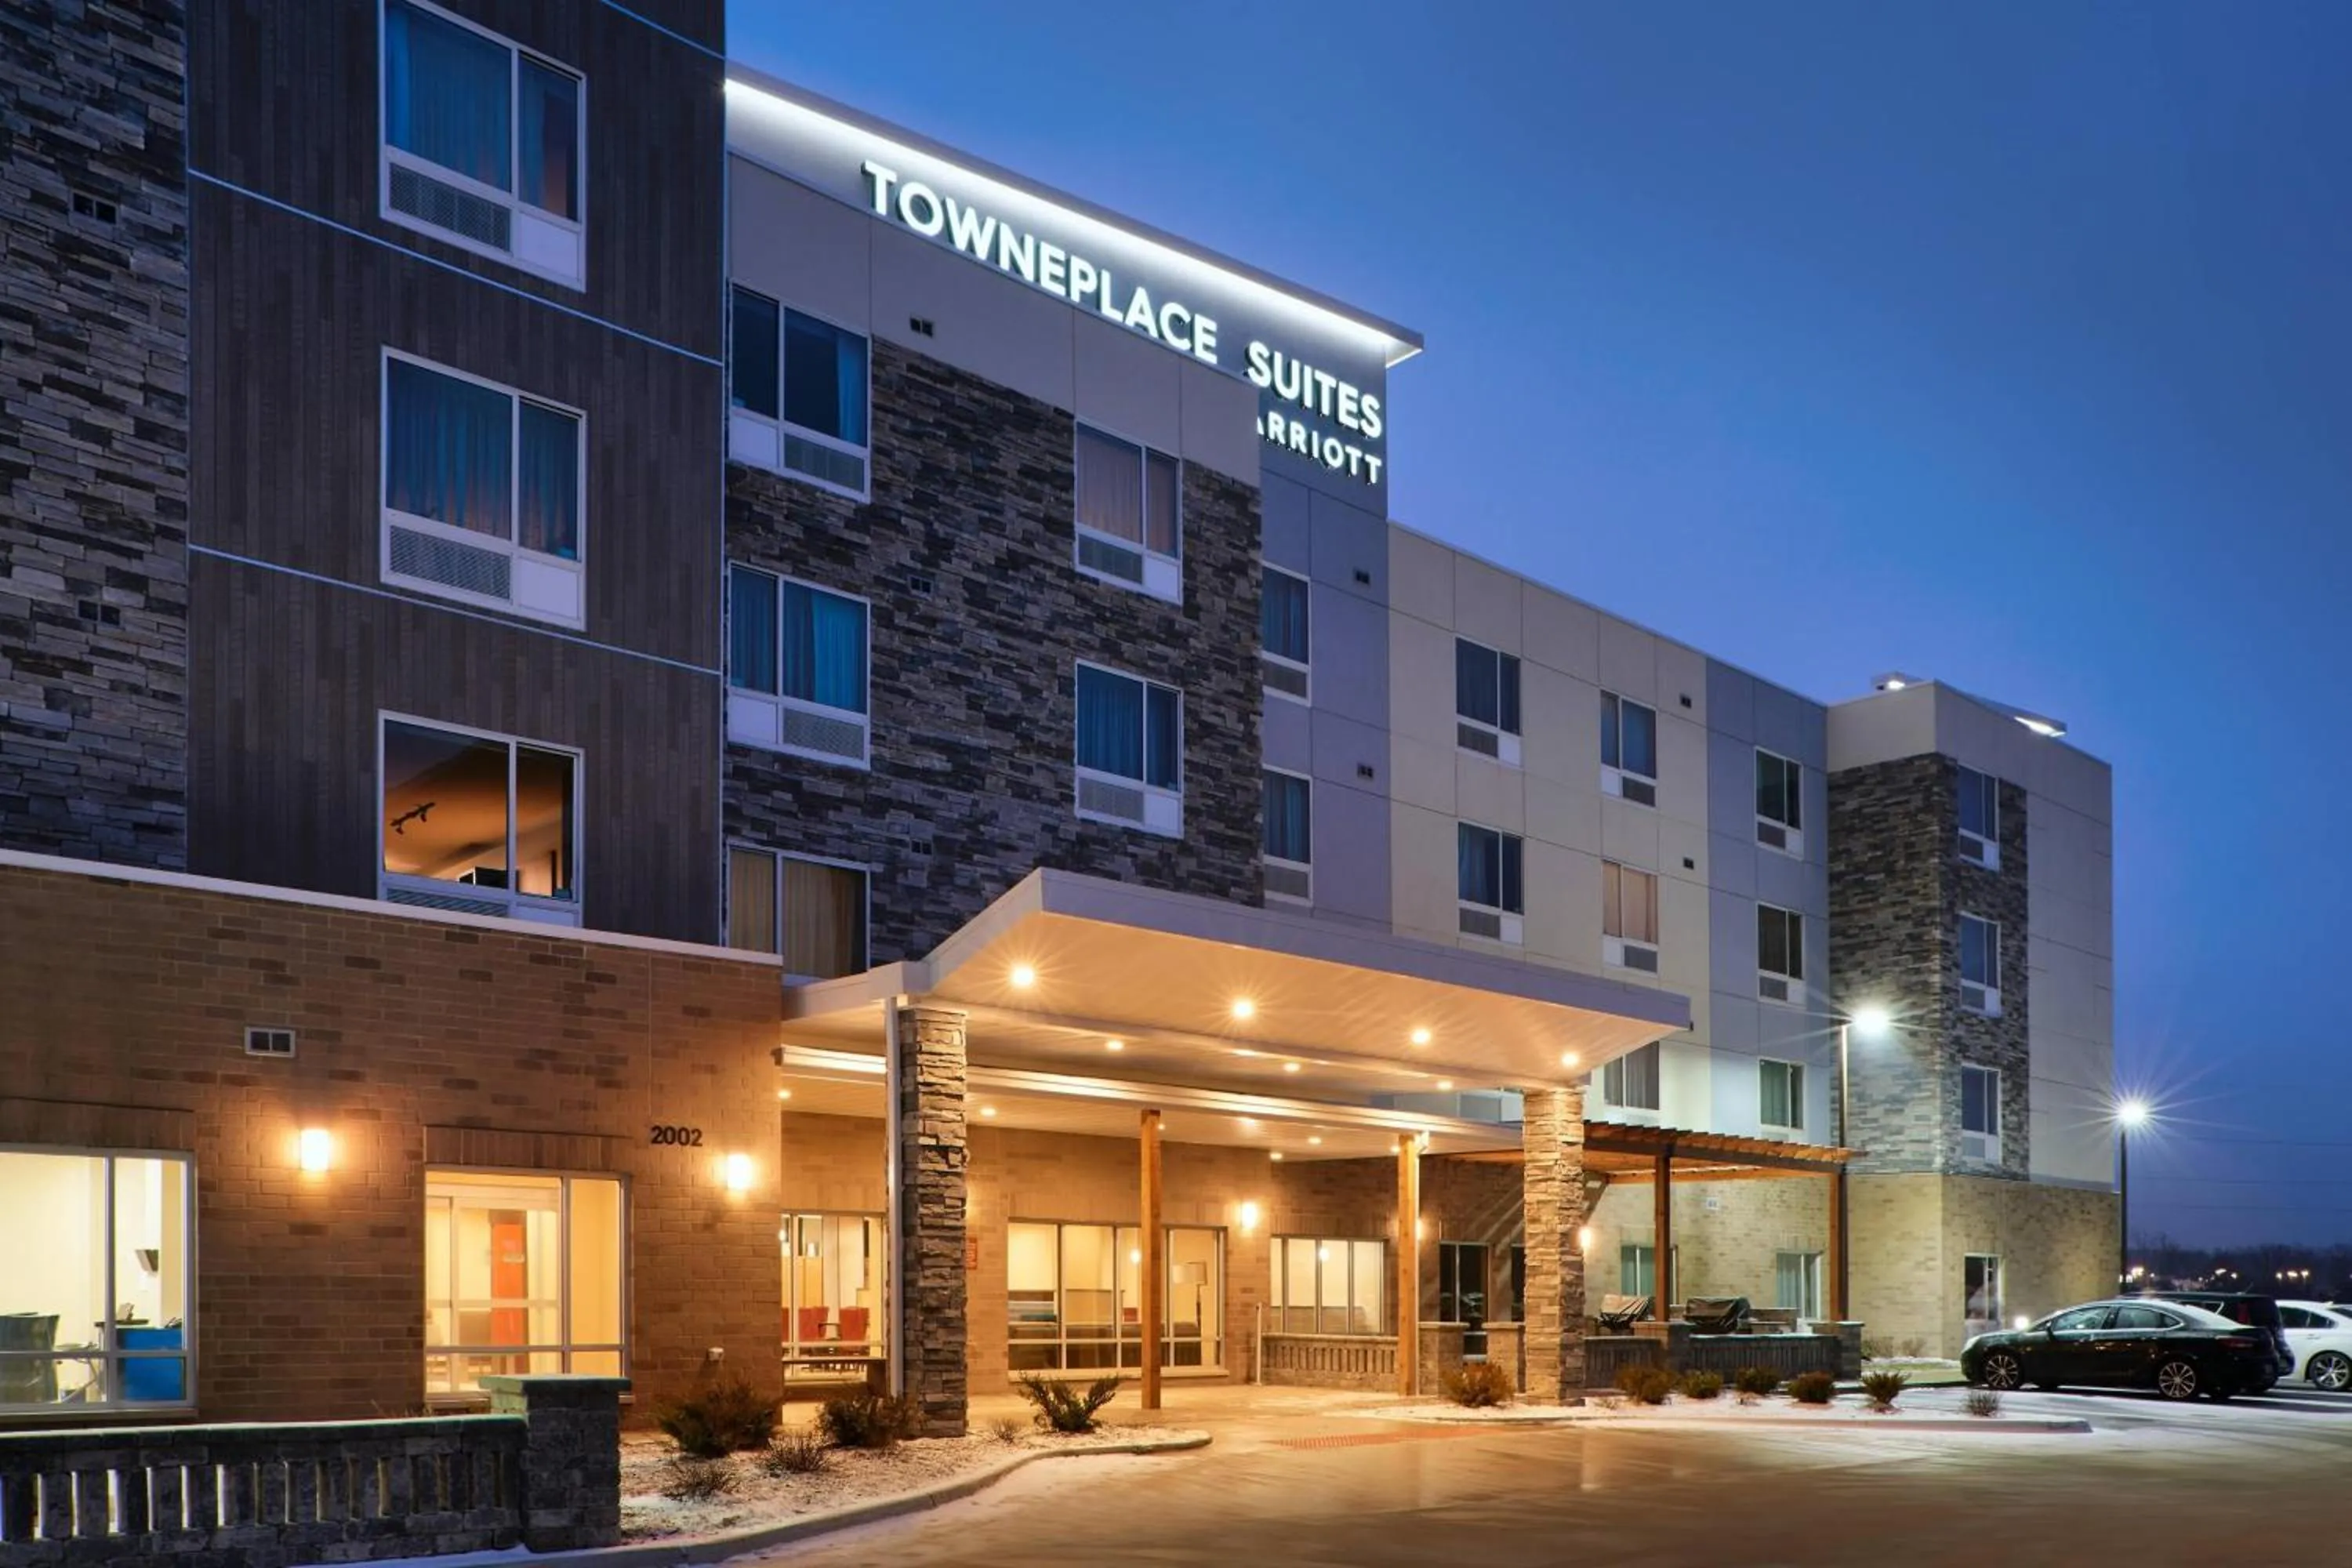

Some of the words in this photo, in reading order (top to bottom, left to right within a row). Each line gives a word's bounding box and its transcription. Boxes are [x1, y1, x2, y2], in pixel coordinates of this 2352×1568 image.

[862, 159, 1218, 365] TOWNEPLACE
[1246, 339, 1382, 439] SUITES
[650, 1125, 703, 1147] 2002
